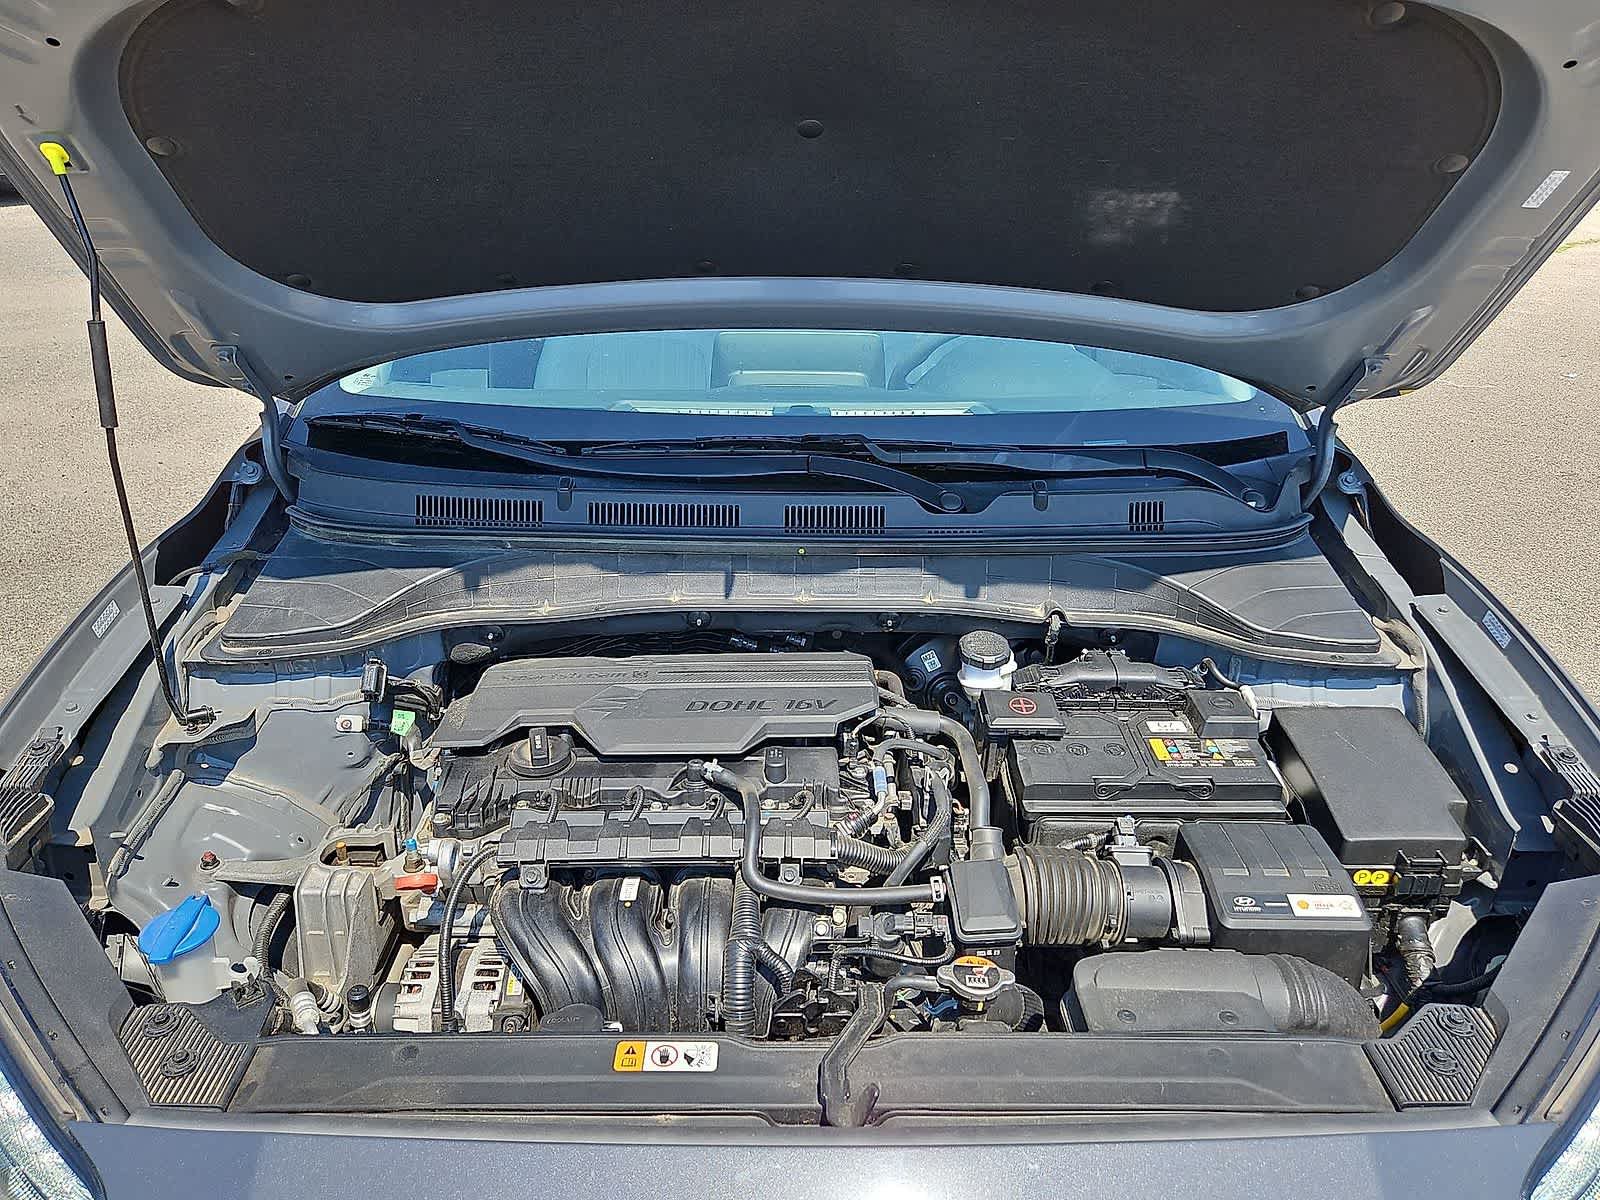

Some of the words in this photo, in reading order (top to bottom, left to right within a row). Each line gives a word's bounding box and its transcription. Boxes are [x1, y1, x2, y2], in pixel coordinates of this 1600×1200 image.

[685, 699, 777, 712] DOHC
[784, 698, 838, 712] 16V
[1358, 872, 1368, 882] P
